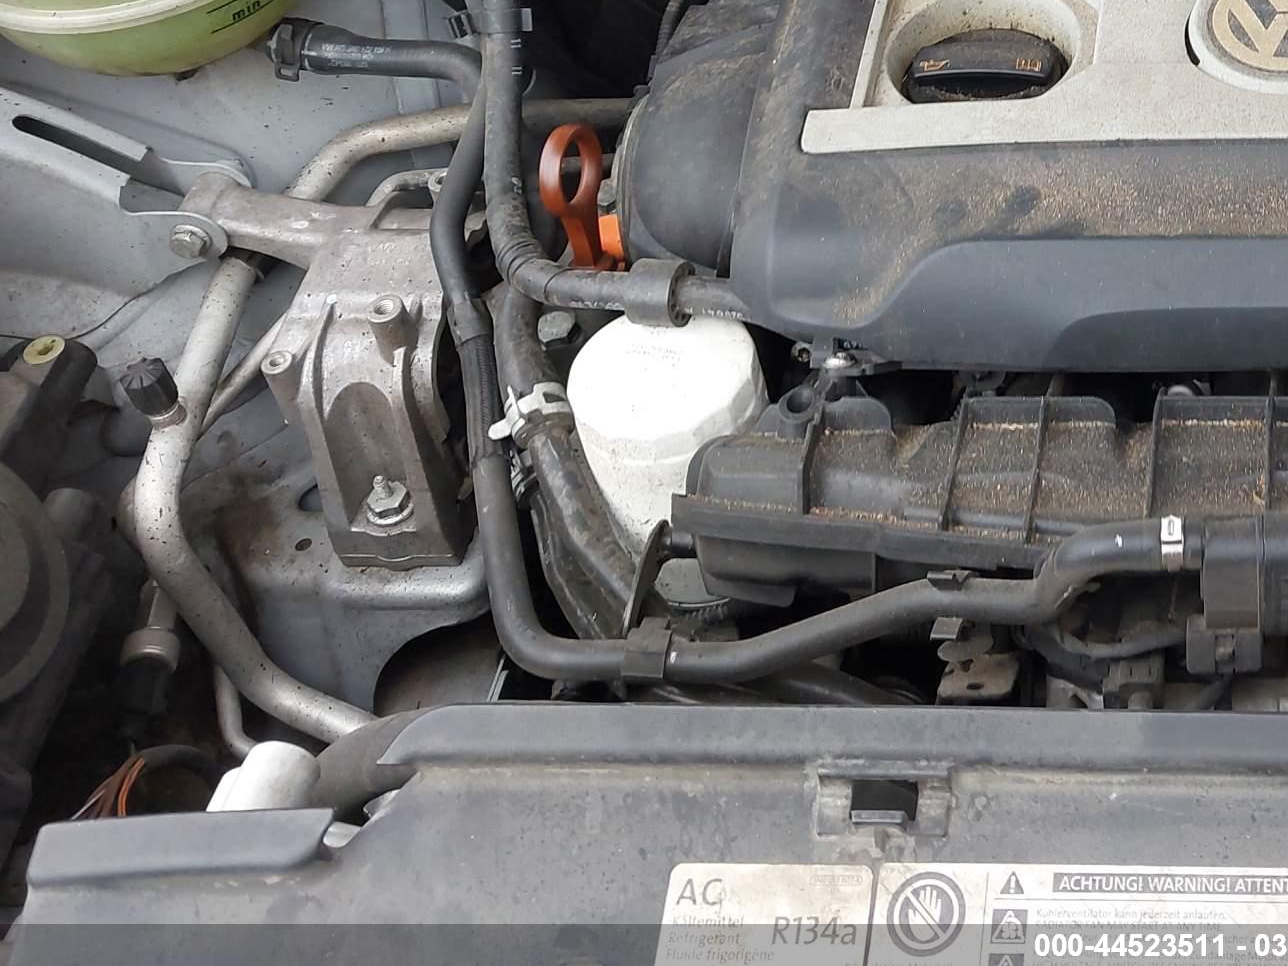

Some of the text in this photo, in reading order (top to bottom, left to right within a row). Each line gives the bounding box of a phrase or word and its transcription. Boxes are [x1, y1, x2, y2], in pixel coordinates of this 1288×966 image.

[231, 0, 262, 22] min
[1058, 875, 1143, 892] ACHTUNG!
[1149, 876, 1231, 893] WARNING!
[772, 916, 857, 946] R134a
